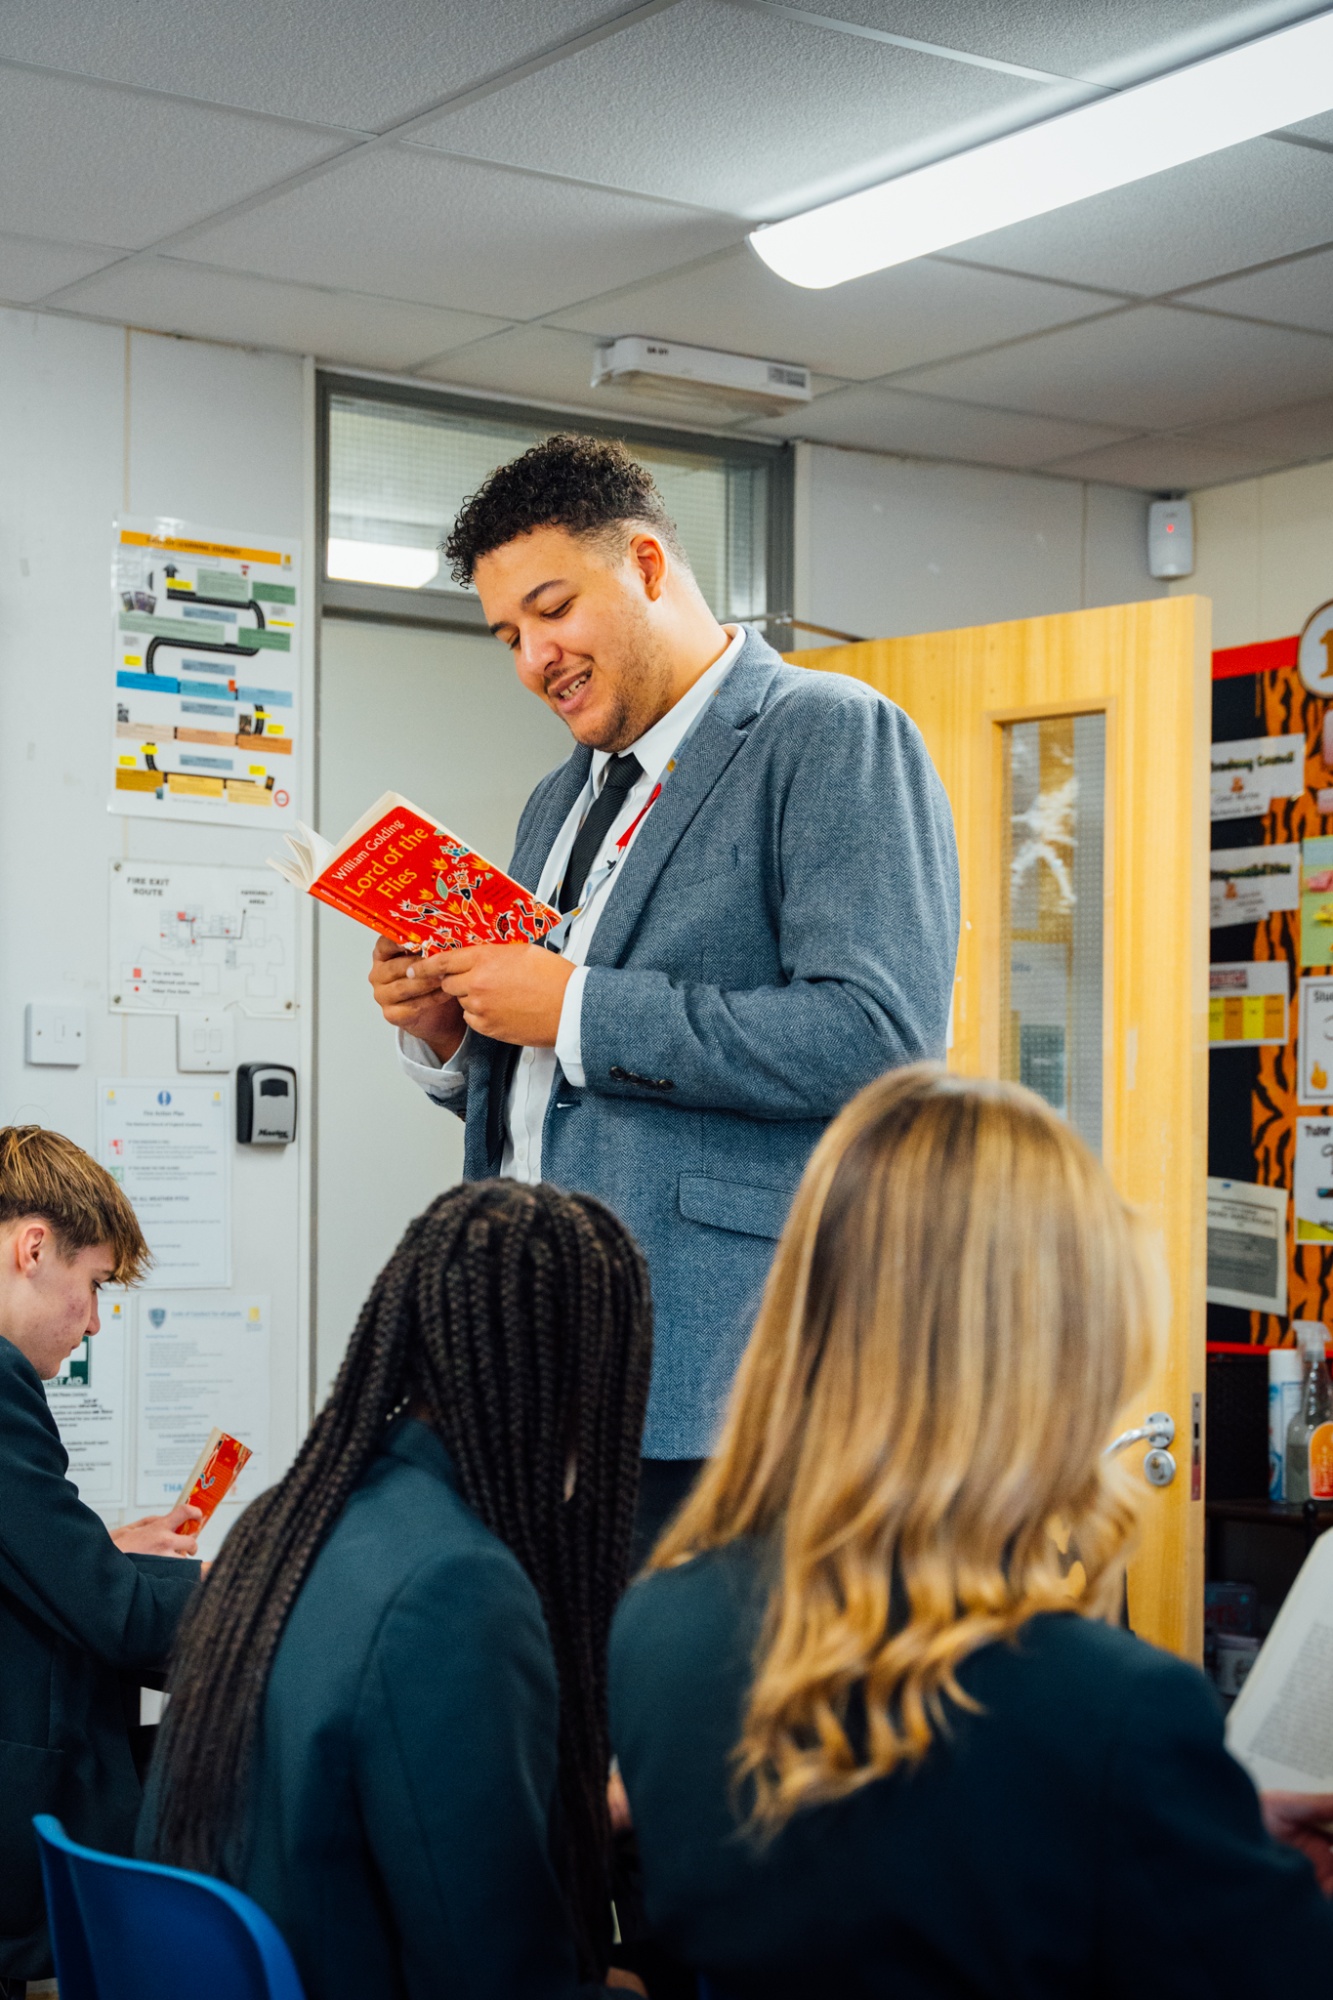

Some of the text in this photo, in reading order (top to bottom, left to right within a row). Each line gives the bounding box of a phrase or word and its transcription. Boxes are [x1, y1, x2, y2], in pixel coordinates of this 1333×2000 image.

[331, 819, 406, 881] William Golding
[344, 828, 429, 898] Lord of the
[126, 876, 170, 887] FIRE EXIT
[375, 868, 418, 900] Flies
[133, 887, 163, 897] ROUTE
[65, 1375, 84, 1386] AID
[163, 1483, 182, 1493] THA
